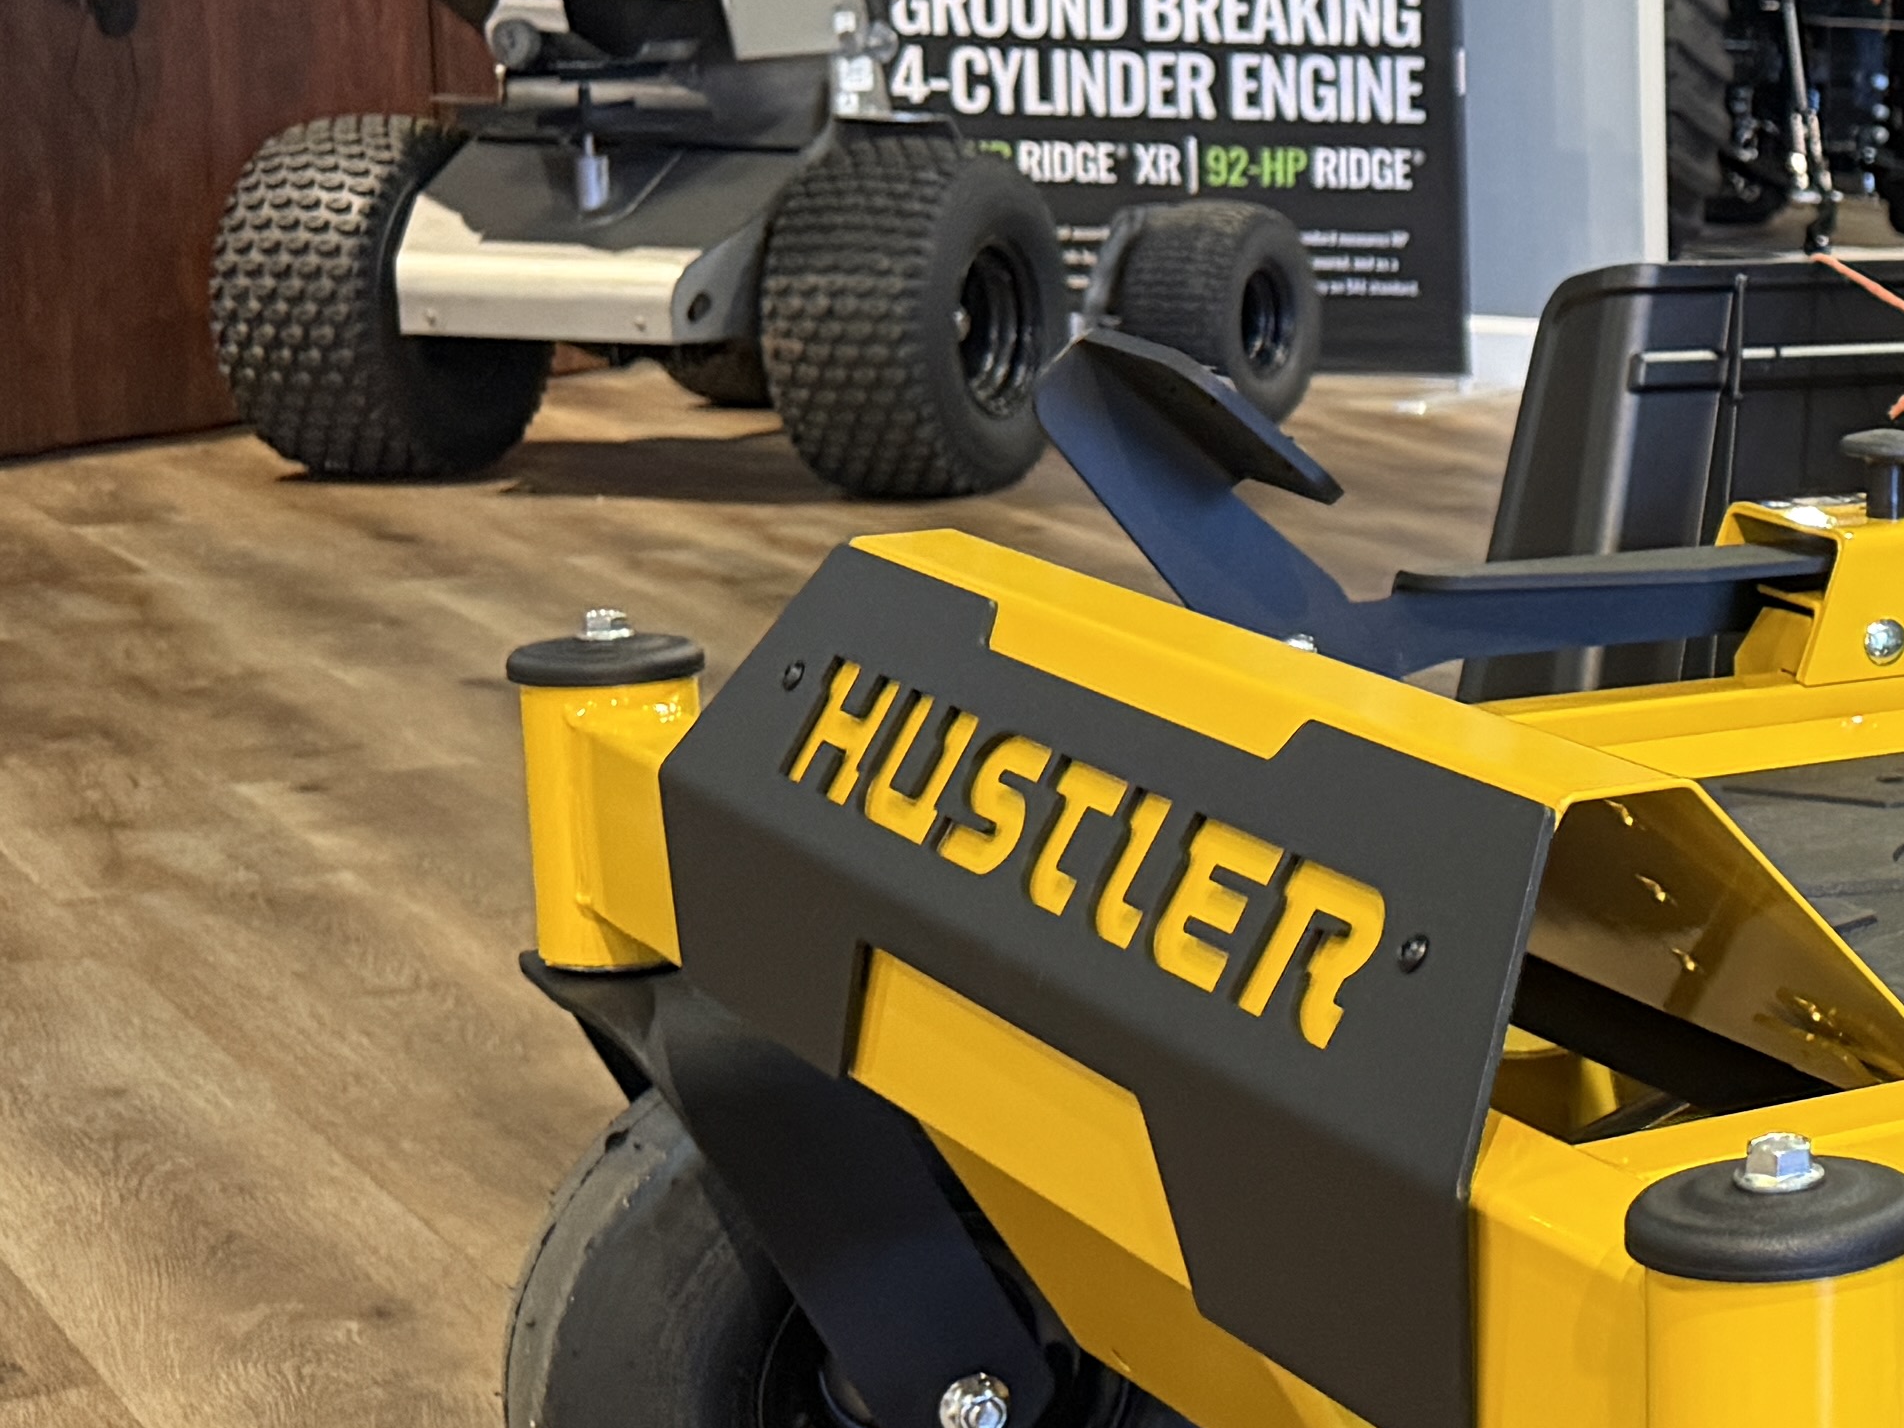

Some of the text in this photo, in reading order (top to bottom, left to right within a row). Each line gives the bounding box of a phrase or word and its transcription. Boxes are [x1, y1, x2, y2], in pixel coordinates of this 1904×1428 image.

[889, 44, 1427, 126] 4-CYLINDER ENGINE
[1133, 142, 1181, 186] XR
[1205, 144, 1308, 189] 92-HP
[784, 655, 1388, 1051] HUSTLER
